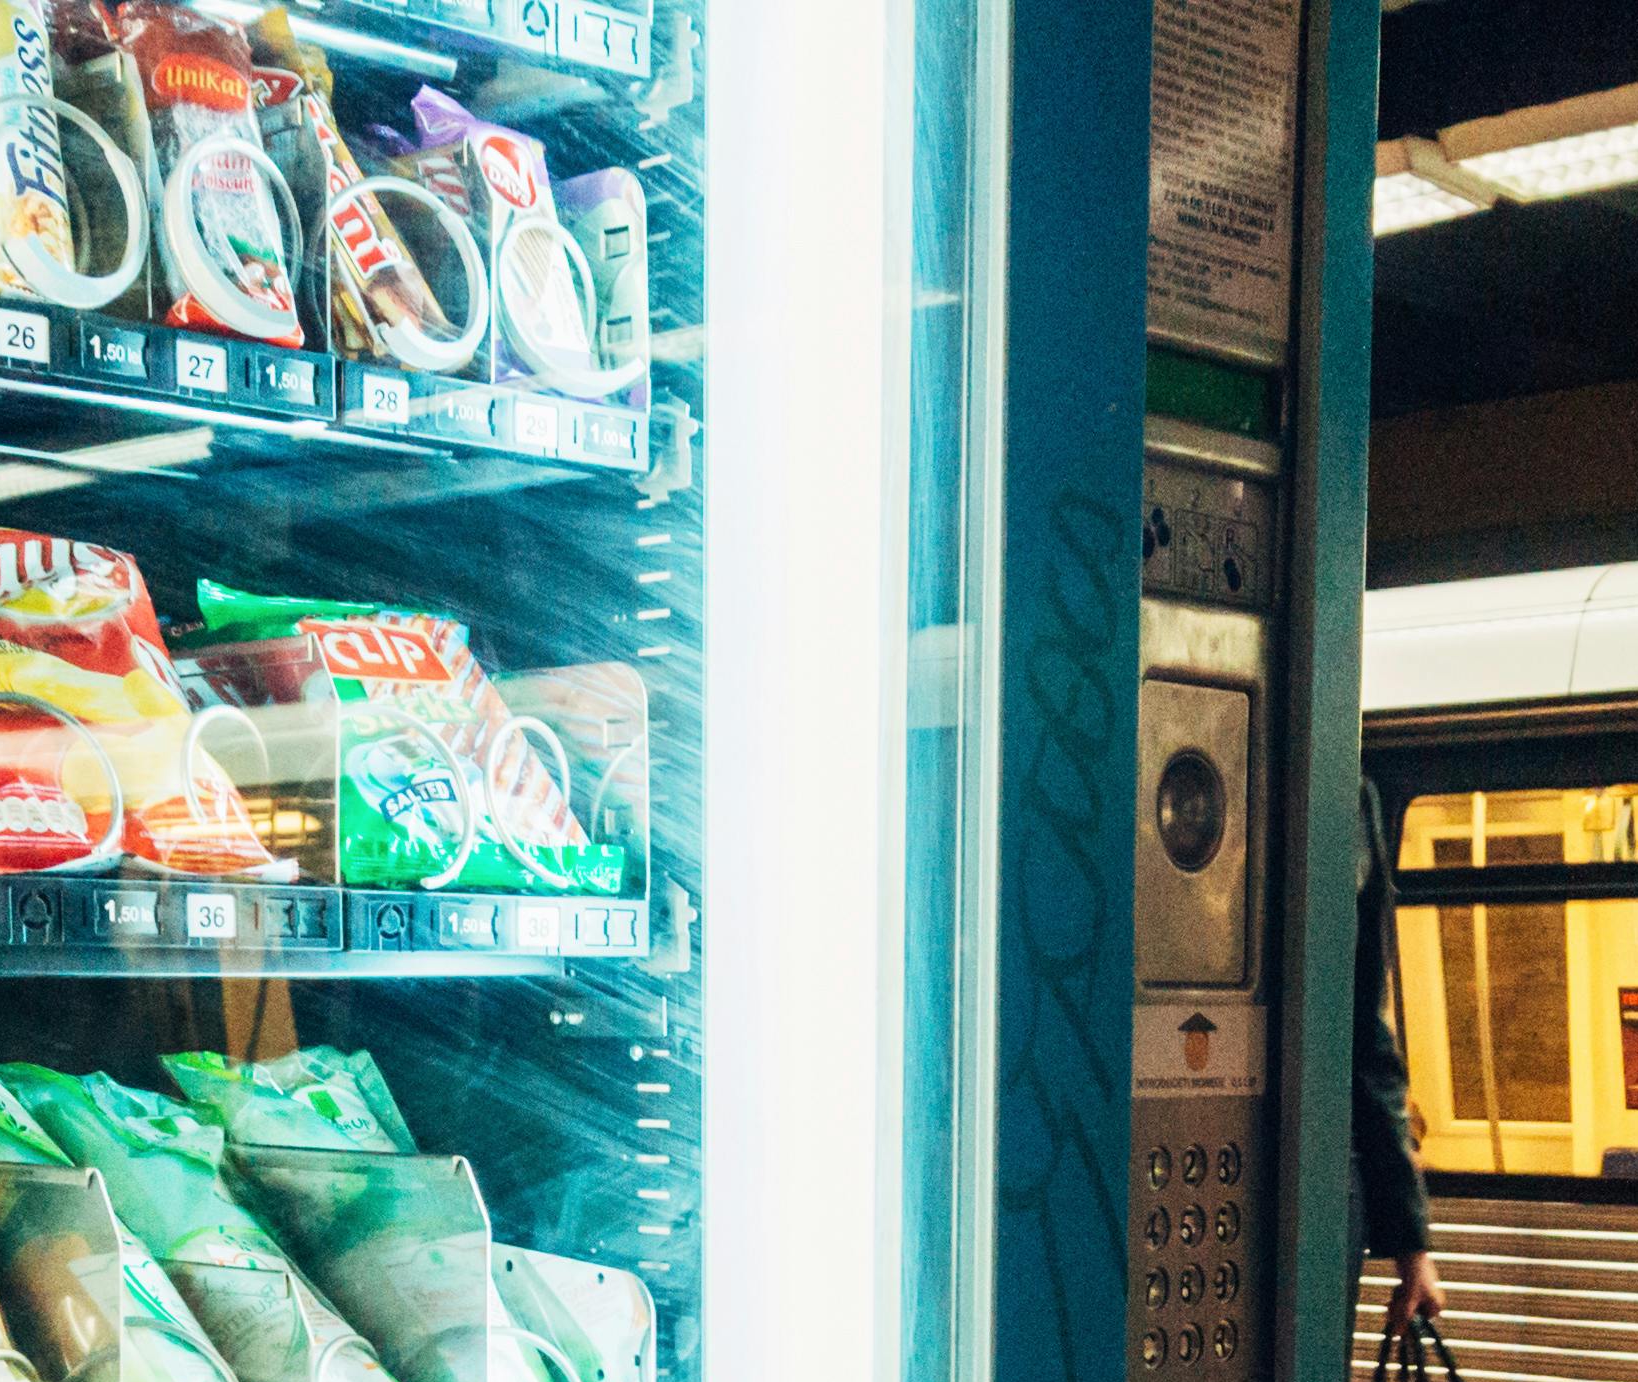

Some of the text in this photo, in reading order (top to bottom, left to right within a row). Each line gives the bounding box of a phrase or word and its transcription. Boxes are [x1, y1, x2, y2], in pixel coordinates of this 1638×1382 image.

[166, 64, 247, 99] UniKat
[6, 324, 37, 350] 26
[188, 355, 215, 380] 27
[374, 388, 399, 413] 28
[525, 415, 548, 438] 29
[321, 625, 427, 675] CLIP
[349, 691, 480, 738] SCKS
[384, 777, 453, 819] SALTED
[198, 905, 226, 928] 36
[527, 917, 551, 938] 38
